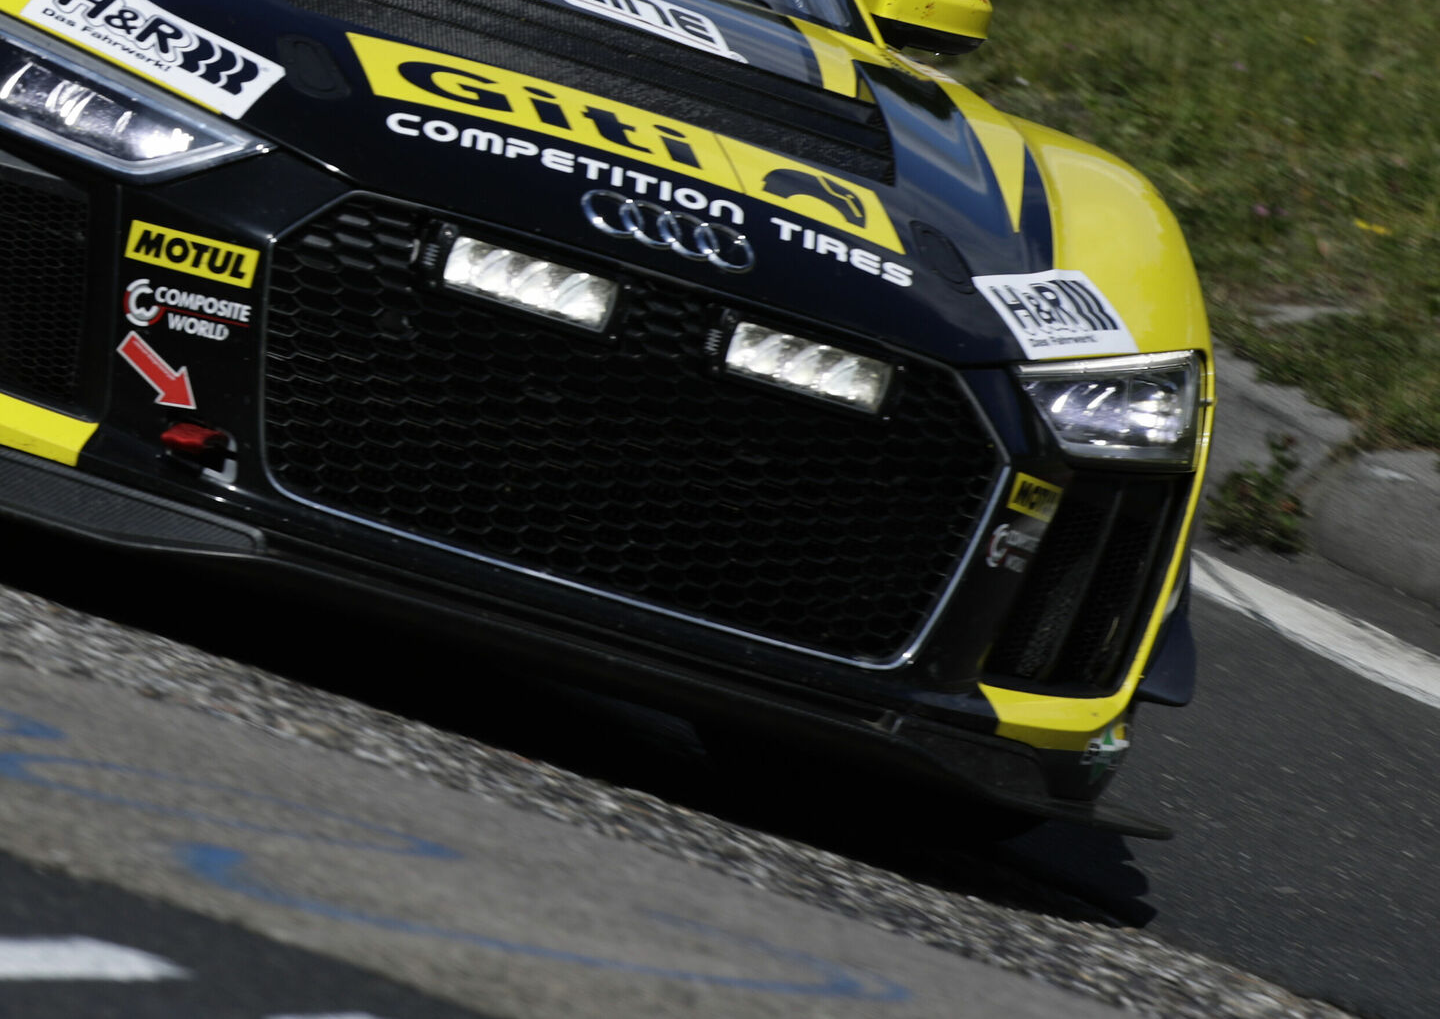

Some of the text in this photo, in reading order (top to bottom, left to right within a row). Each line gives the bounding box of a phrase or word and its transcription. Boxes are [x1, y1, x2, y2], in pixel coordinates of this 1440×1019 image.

[42, 7, 76, 26] Das
[398, 62, 705, 170] Giti
[386, 112, 914, 288] COMPETITION TIRES
[134, 230, 246, 279] MOTUL
[155, 286, 252, 322] COMPOSITE
[167, 313, 229, 341] WORLD
